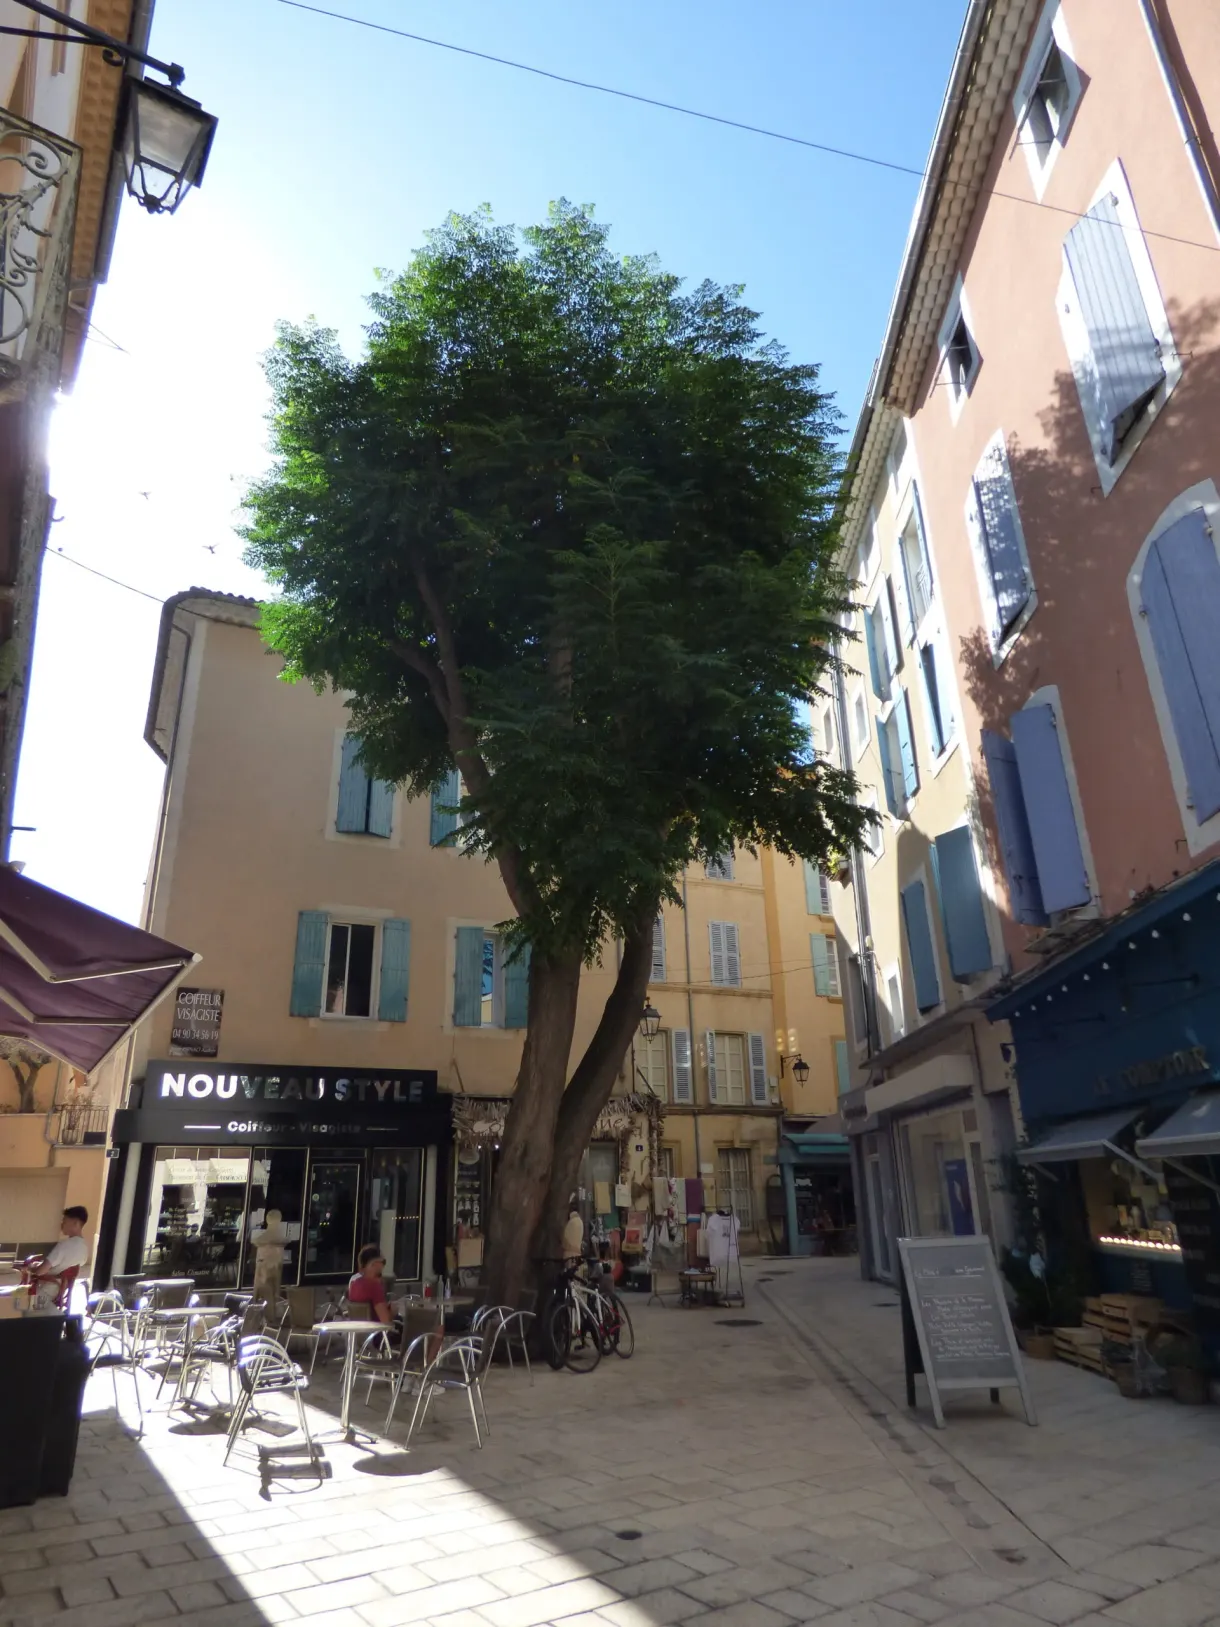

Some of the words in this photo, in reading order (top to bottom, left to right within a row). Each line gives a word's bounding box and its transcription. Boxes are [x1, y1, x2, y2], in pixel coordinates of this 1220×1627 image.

[178, 992, 221, 1007] COIFFEUR
[177, 1007, 220, 1022] VISAGISTE
[172, 1028, 181, 1038] 04
[182, 1028, 191, 1038] 90
[211, 1030, 219, 1040] 19
[161, 1073, 325, 1100] NOUVEAU
[334, 1078, 423, 1102] STYLE
[227, 1120, 285, 1133] Coiffeur
[300, 1121, 361, 1135] Visagiste
